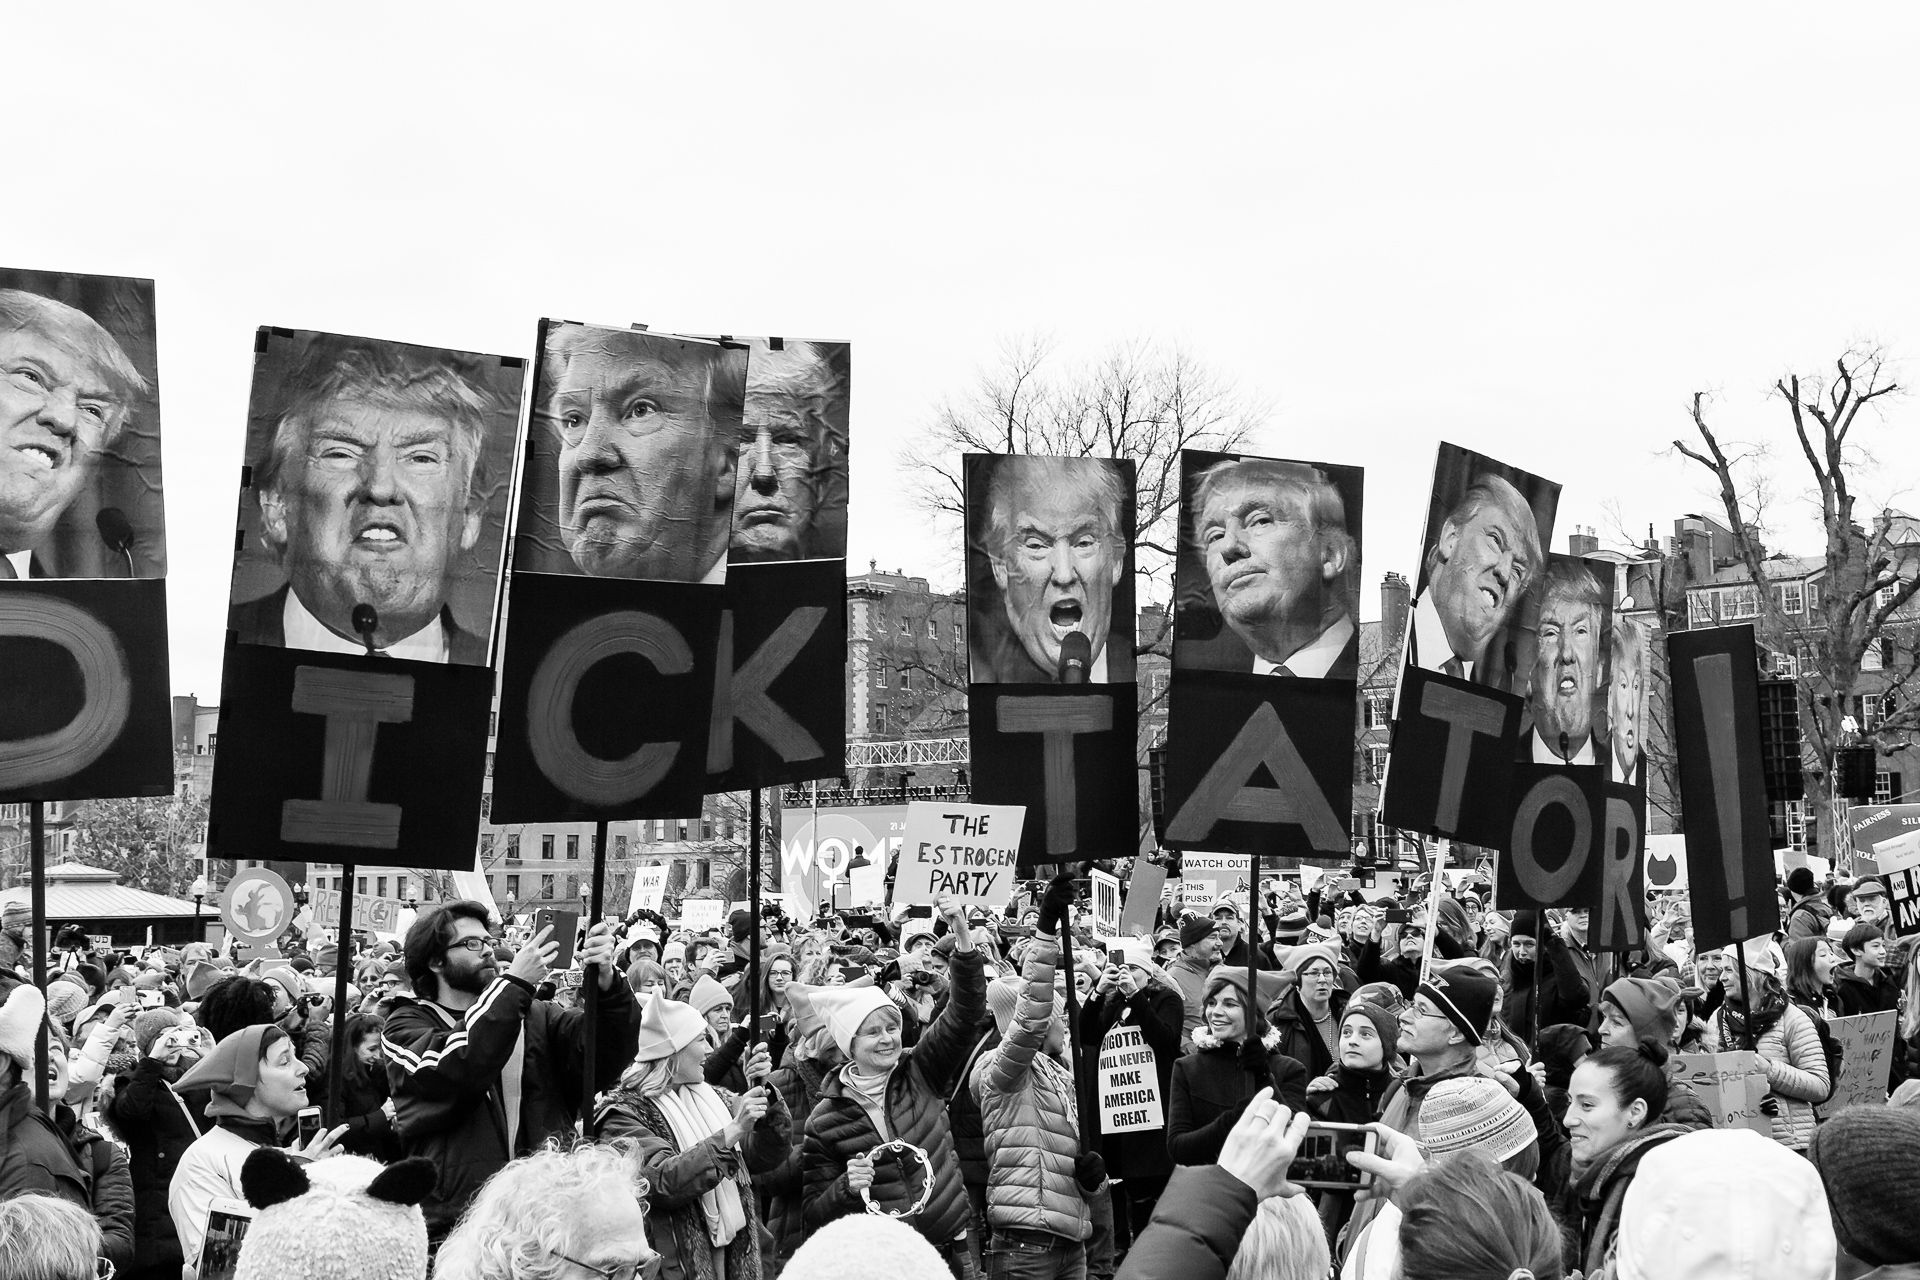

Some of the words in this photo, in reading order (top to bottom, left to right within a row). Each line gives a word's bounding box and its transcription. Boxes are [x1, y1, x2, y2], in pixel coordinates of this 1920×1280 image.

[0, 591, 131, 791] D
[280, 665, 415, 849] I
[527, 610, 694, 806] C
[705, 606, 828, 774] K
[996, 695, 1113, 855] T
[1164, 701, 1350, 853] A
[1420, 680, 1507, 834] T
[1511, 774, 1592, 903] O
[1600, 797, 1638, 947] R
[1693, 653, 1748, 939] !
[942, 814, 990, 837] THE
[1853, 808, 1892, 832] FAIRNESS
[917, 842, 1016, 866] ESTROGEN
[1184, 859, 1223, 868] WATCH
[1227, 859, 1250, 868] OUT
[642, 876, 660, 888] WAR
[929, 869, 998, 896] PARTY
[1185, 883, 1205, 891] THIS
[1893, 880, 1905, 890] AND
[313, 890, 400, 930] REPECT
[643, 894, 652, 907] IS
[1102, 1030, 1143, 1052] BIGOTR
[1100, 1055, 1119, 1070] WILL
[1119, 1050, 1153, 1067] NEVER
[1109, 1070, 1142, 1088] MAKE
[1104, 1088, 1156, 1109] AMERICA
[1112, 1109, 1151, 1127] GREAT.
